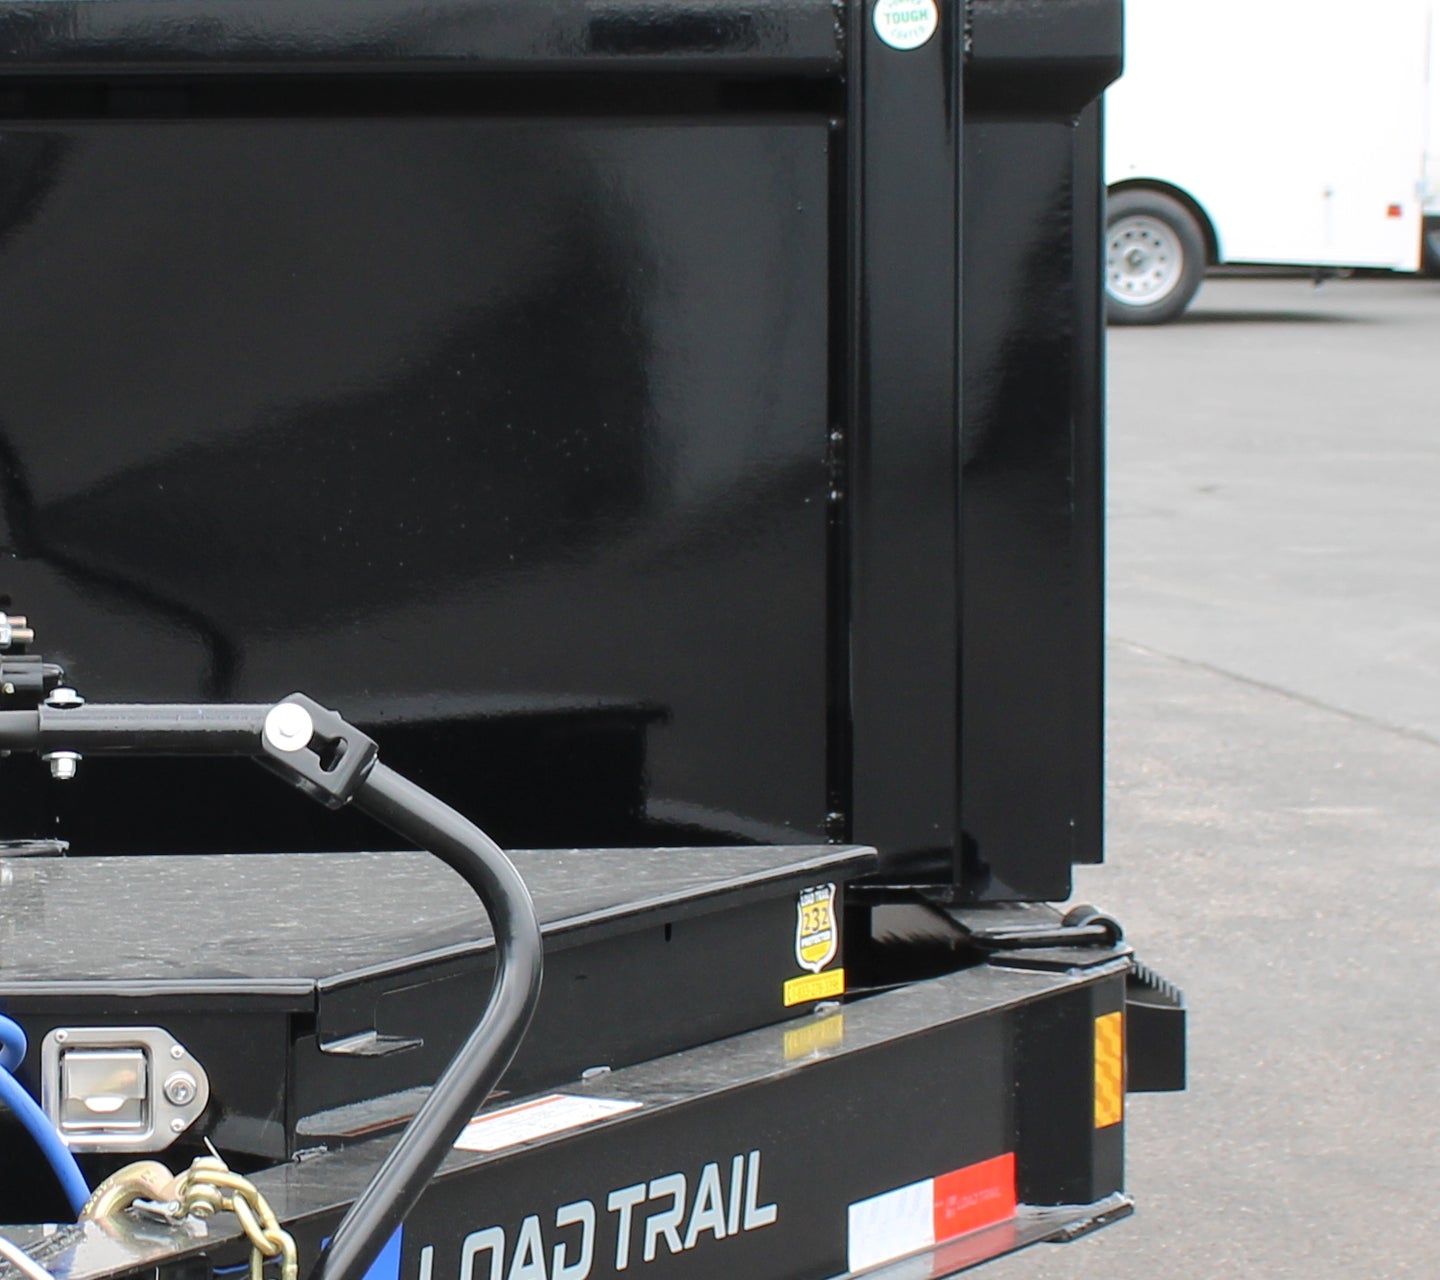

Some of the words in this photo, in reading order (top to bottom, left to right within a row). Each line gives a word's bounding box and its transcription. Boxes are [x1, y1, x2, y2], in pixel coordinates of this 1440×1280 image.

[884, 8, 929, 25] TOUGH
[804, 907, 828, 931] 232
[607, 1149, 779, 1272] TRAIL
